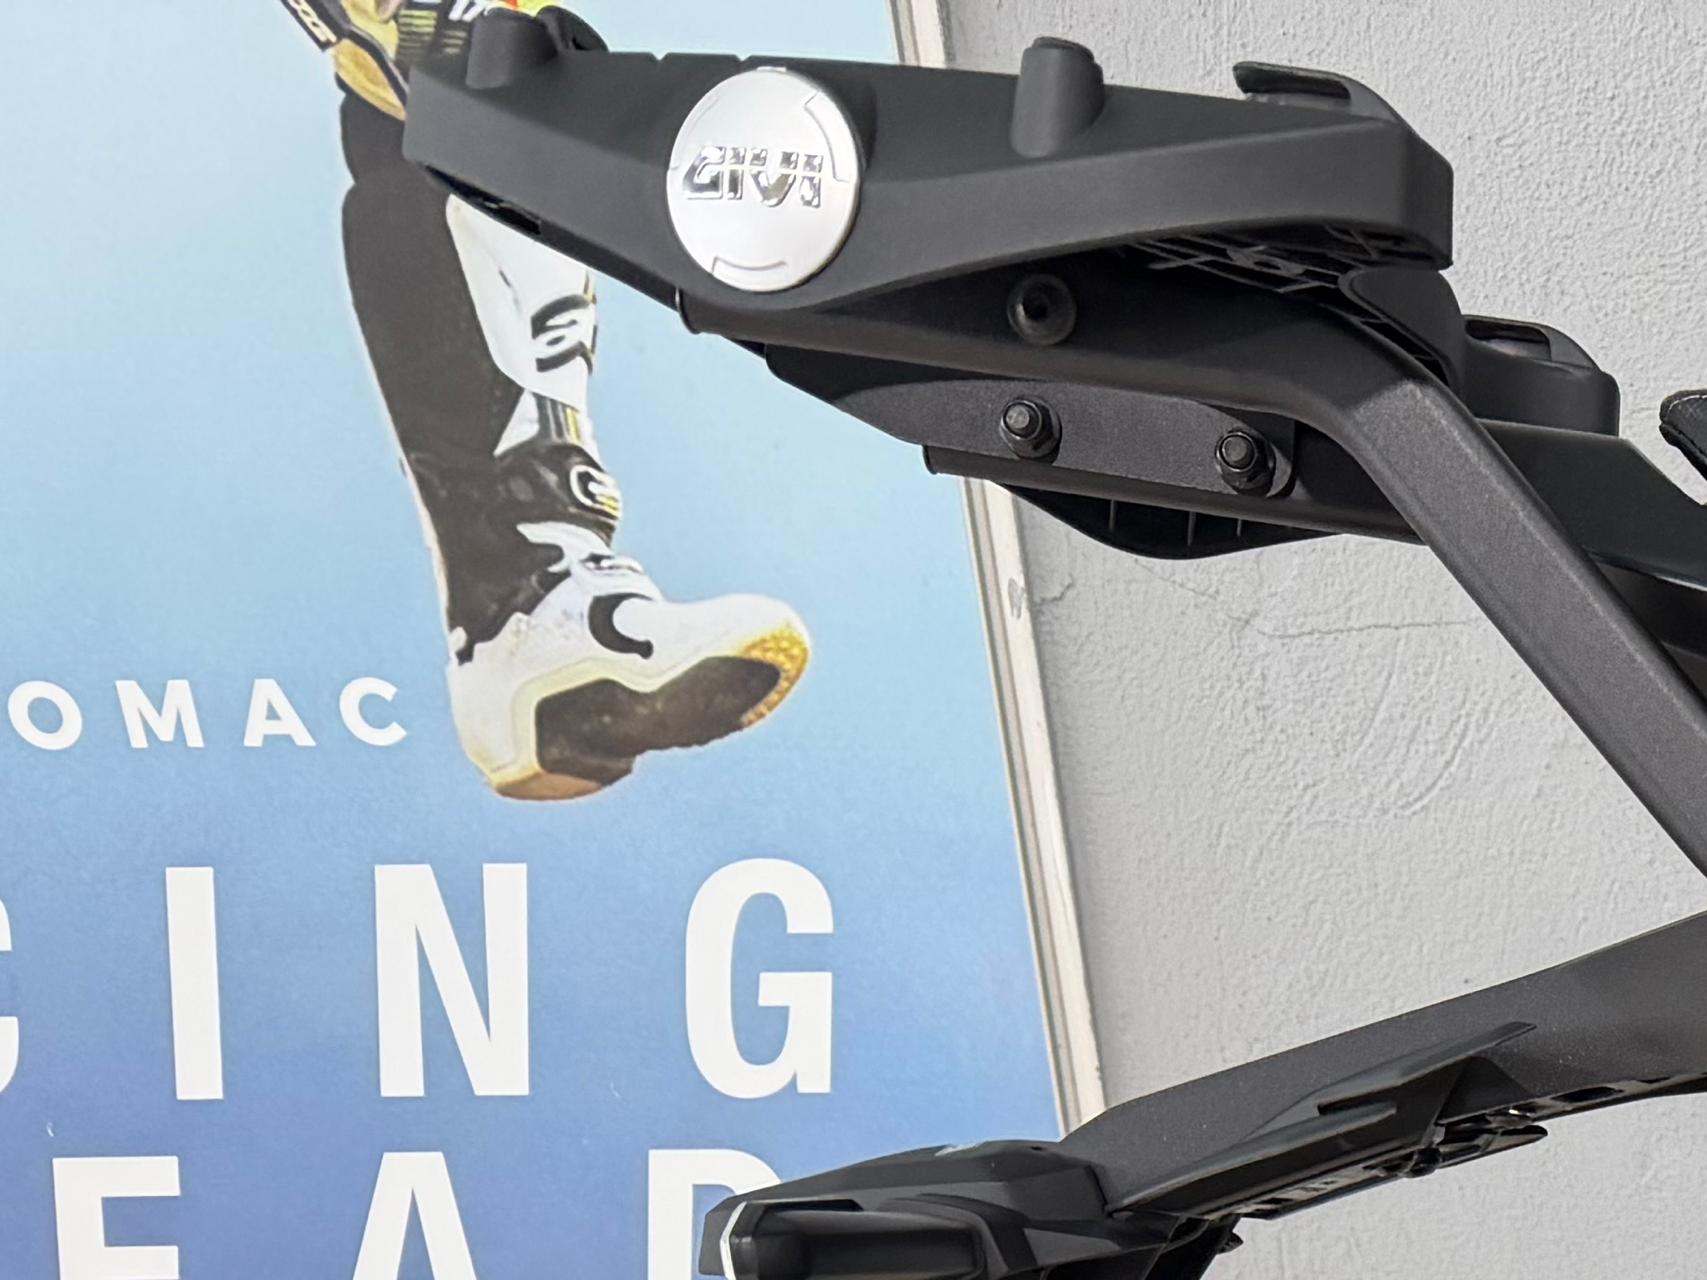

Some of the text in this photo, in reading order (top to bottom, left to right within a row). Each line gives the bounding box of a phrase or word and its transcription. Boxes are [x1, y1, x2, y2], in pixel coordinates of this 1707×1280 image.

[683, 146, 824, 209] GIVI
[8, 676, 409, 750] OMAC
[0, 857, 835, 1100] ING
